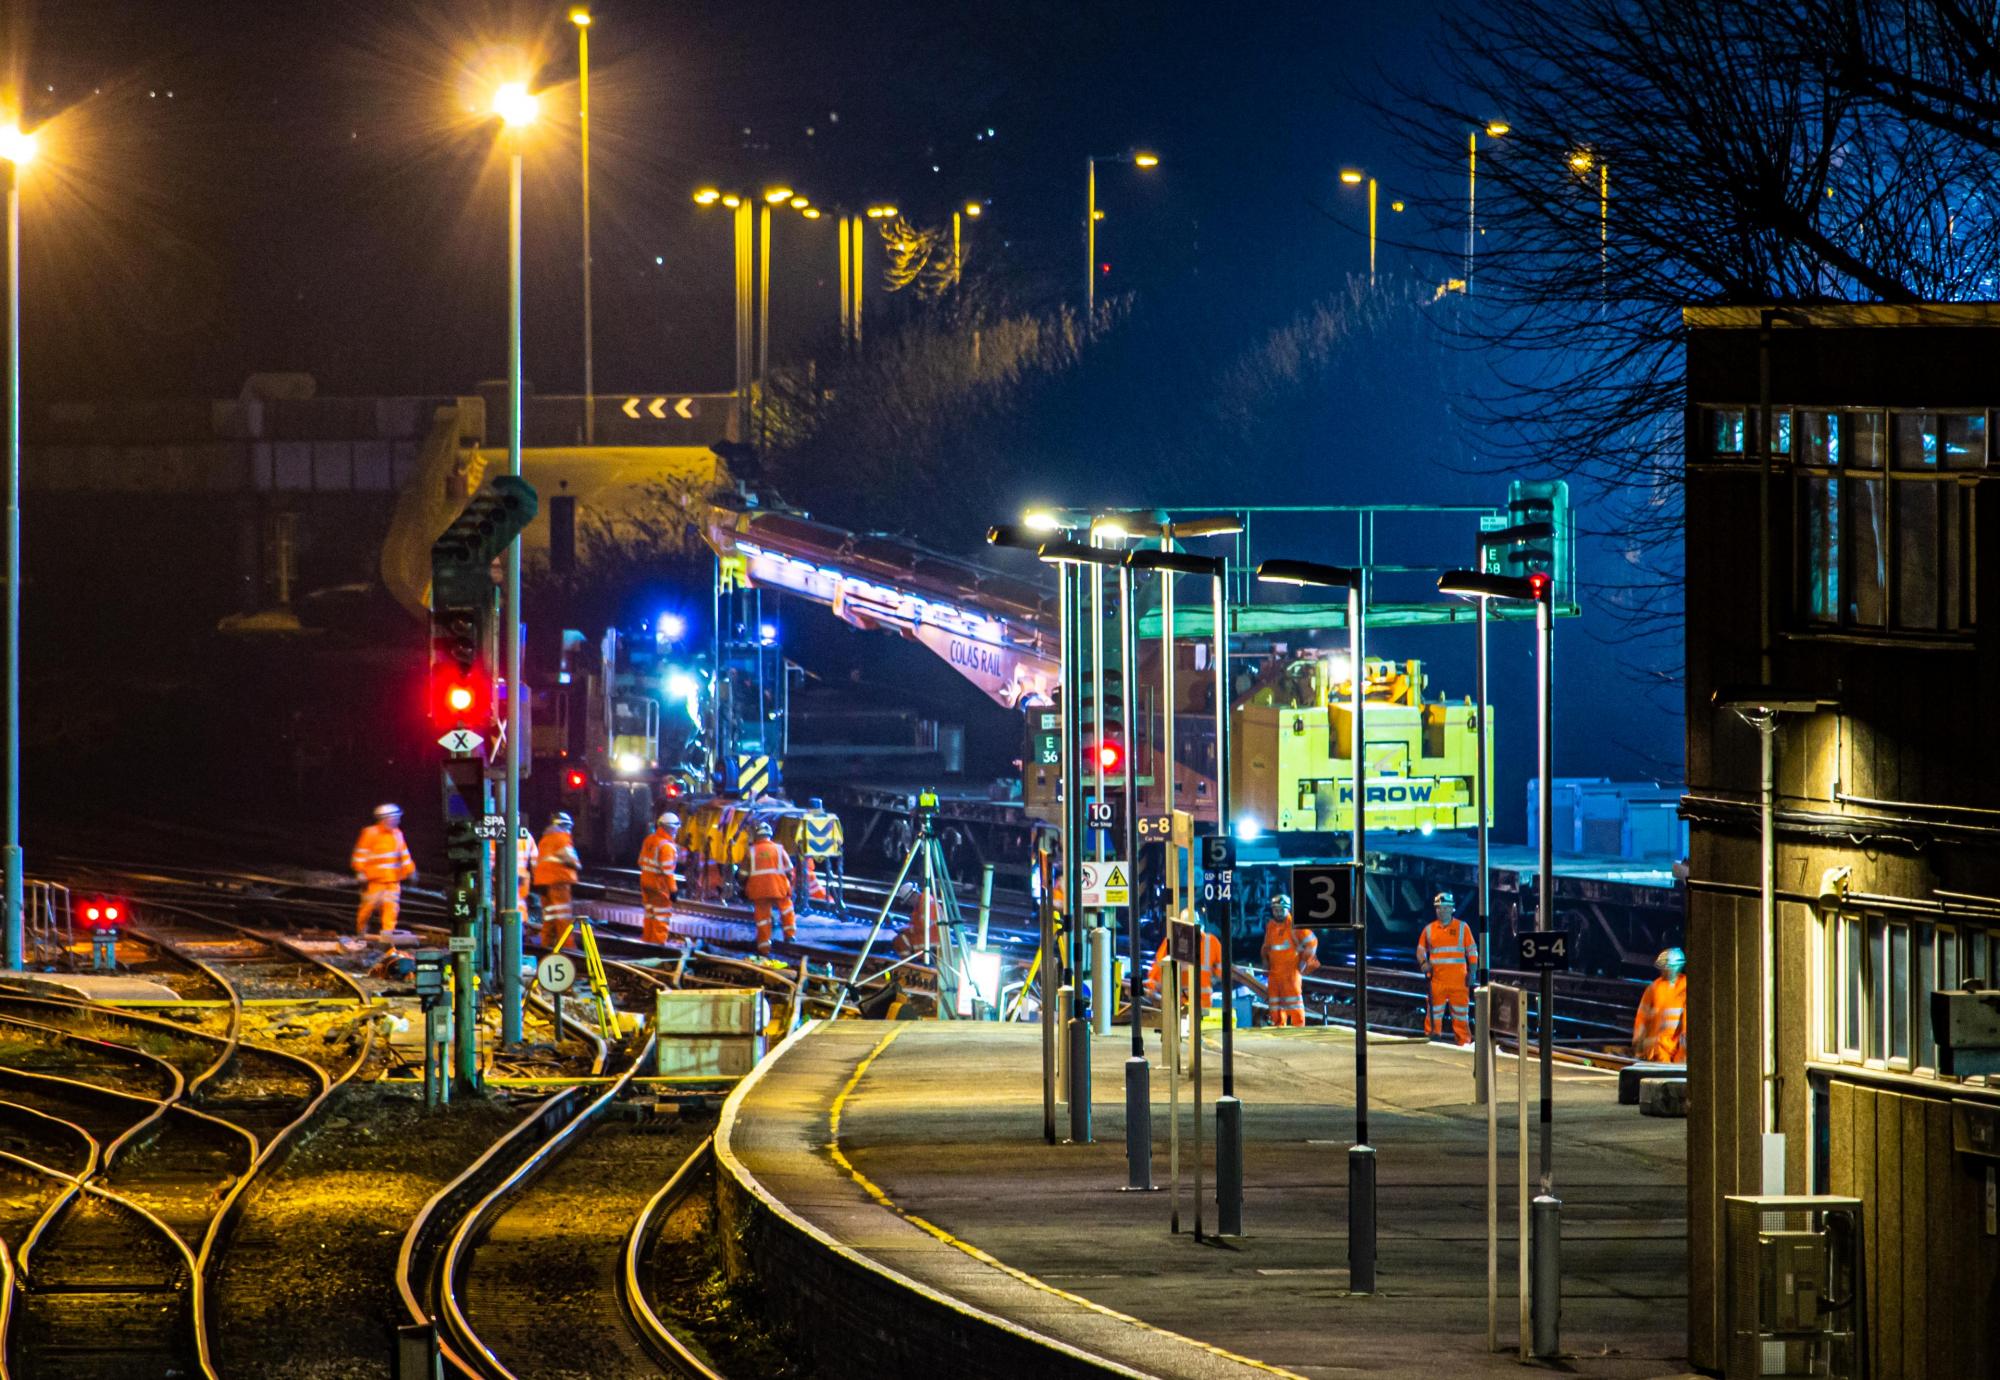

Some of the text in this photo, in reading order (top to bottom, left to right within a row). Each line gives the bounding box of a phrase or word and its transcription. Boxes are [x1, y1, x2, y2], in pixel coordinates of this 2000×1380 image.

[1489, 548, 1497, 561] E
[950, 640, 1002, 677] COLAS RAIL
[1045, 736, 1054, 749] E
[1042, 750, 1059, 763] 36
[1339, 785, 1433, 803] KROW
[1091, 804, 1112, 821] 10
[1137, 817, 1170, 834] 6-8
[1210, 839, 1228, 862] 5
[458, 890, 467, 902] E
[1308, 875, 1337, 919] 3
[454, 904, 471, 916] 34
[1522, 938, 1566, 958] 3-4
[547, 963, 566, 983] 15
